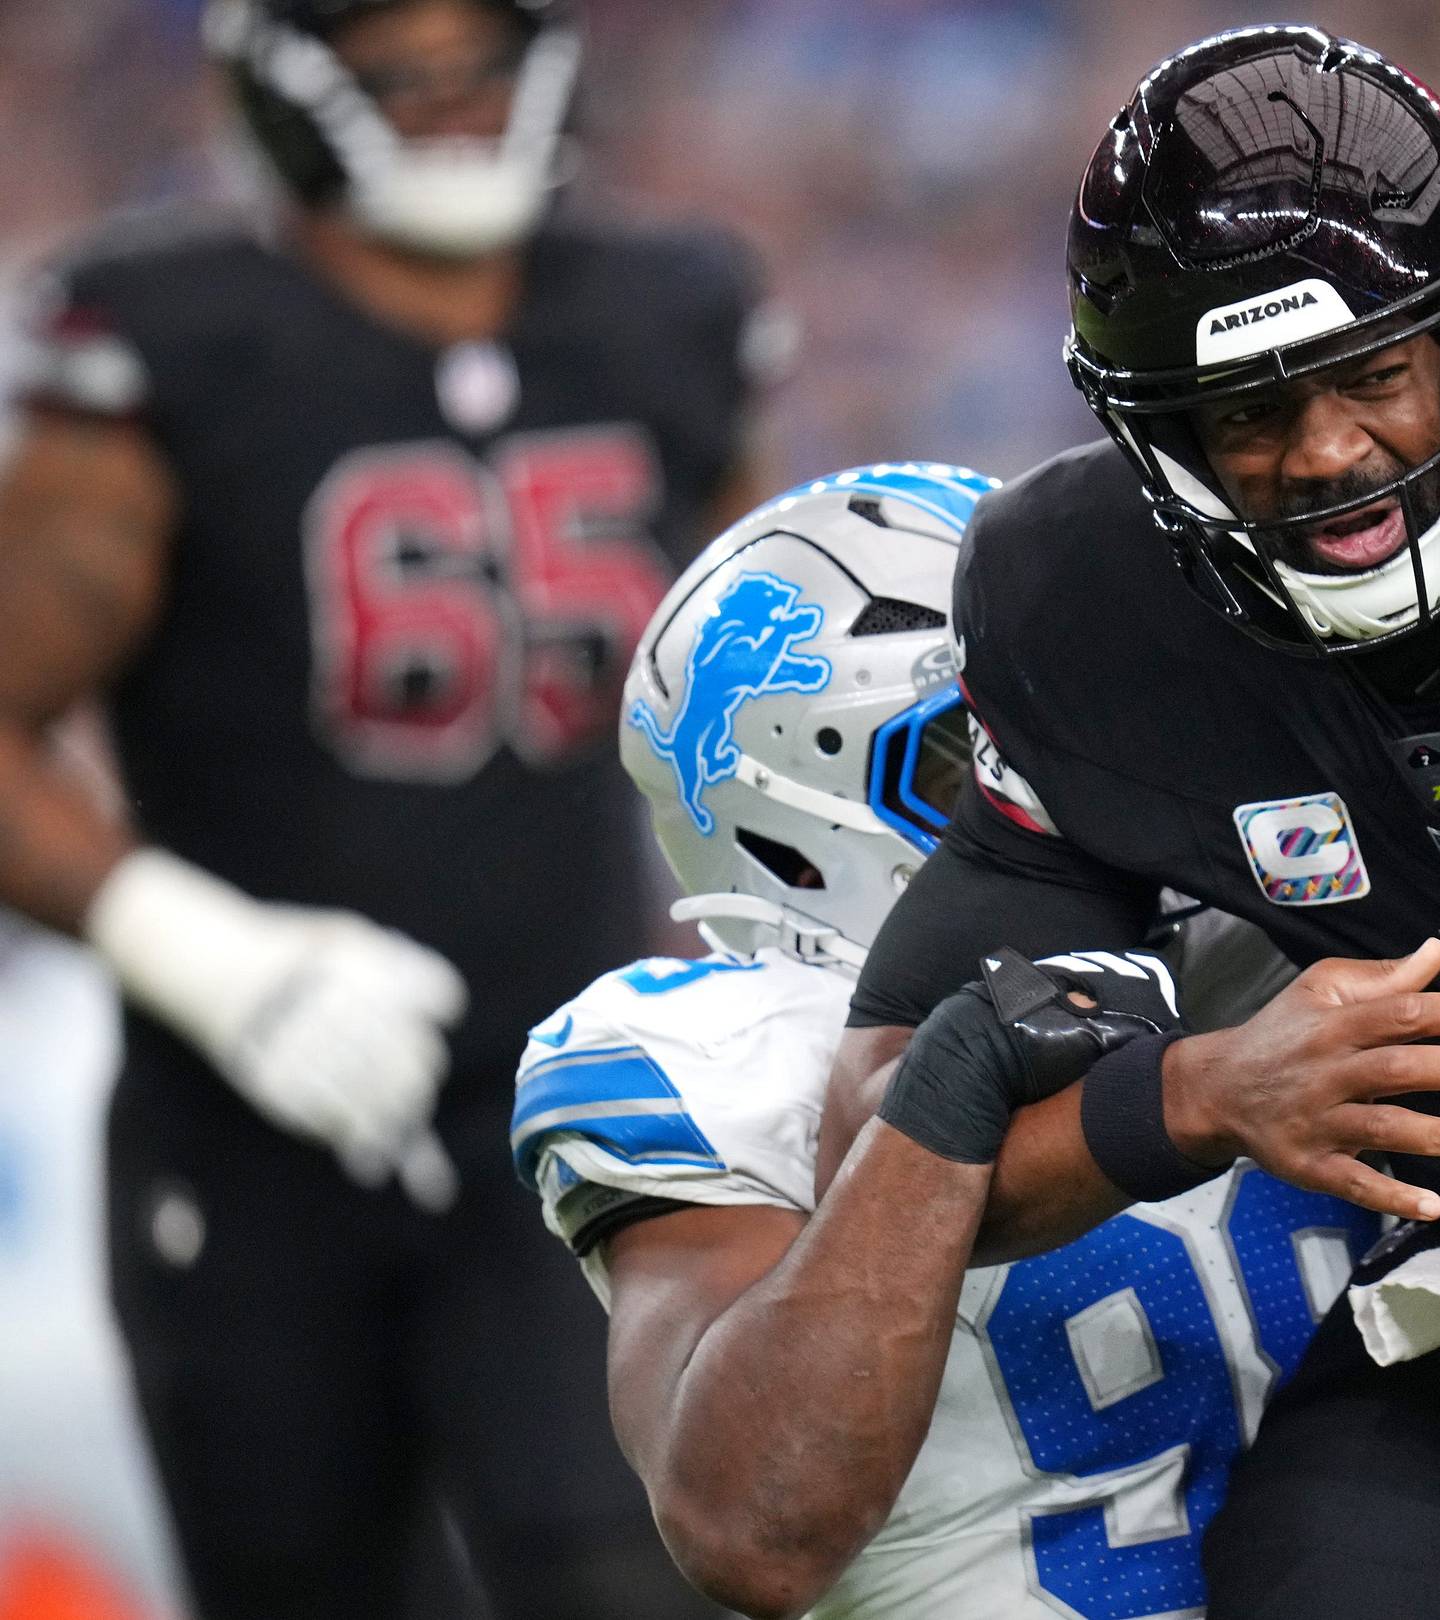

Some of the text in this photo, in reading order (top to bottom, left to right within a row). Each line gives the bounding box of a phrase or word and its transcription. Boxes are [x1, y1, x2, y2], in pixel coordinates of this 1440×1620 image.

[1209, 291, 1319, 336] ARIZONA
[302, 420, 672, 784] 65
[1246, 802, 1351, 880] C
